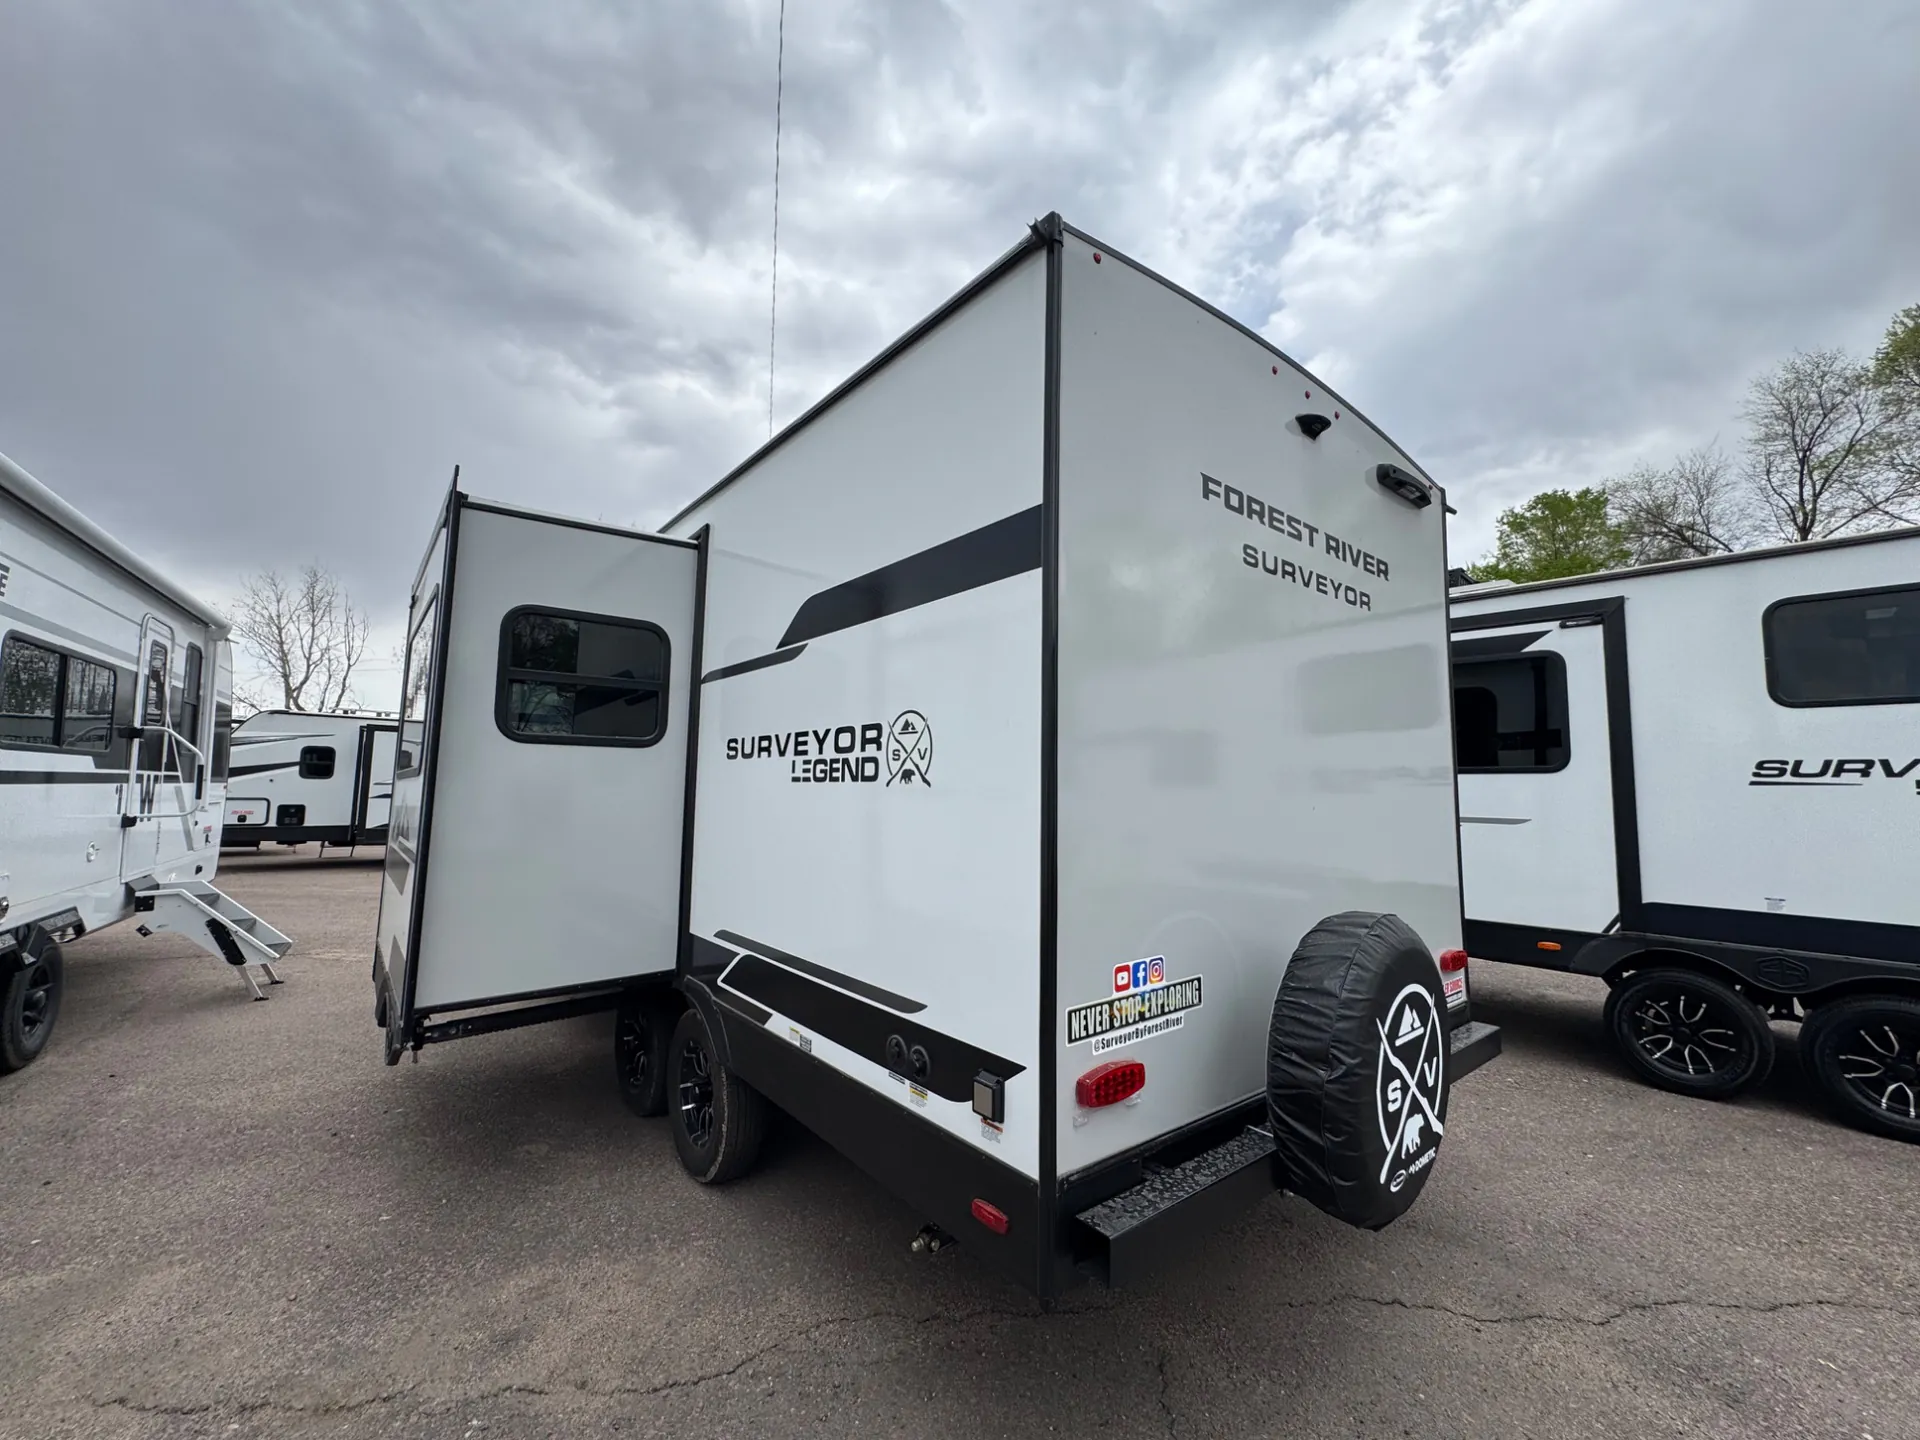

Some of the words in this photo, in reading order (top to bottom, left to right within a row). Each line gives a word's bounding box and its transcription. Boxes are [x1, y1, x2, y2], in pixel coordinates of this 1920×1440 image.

[1200, 472, 1319, 547] FOREST
[1324, 532, 1389, 581] RIVER
[1243, 543, 1371, 611] SURVEYOR
[726, 723, 883, 760] SURVEYOR
[892, 749, 901, 761] S
[917, 747, 928, 760] V
[791, 756, 880, 783] LEGEND
[1071, 1003, 1110, 1040] NEVER
[1113, 993, 1142, 1027] STOP
[1144, 979, 1200, 1019] EXPLORING
[1093, 1015, 1183, 1053] @SurveyorByForestRiver
[1387, 1079, 1402, 1112] S
[1423, 1056, 1438, 1088] V
